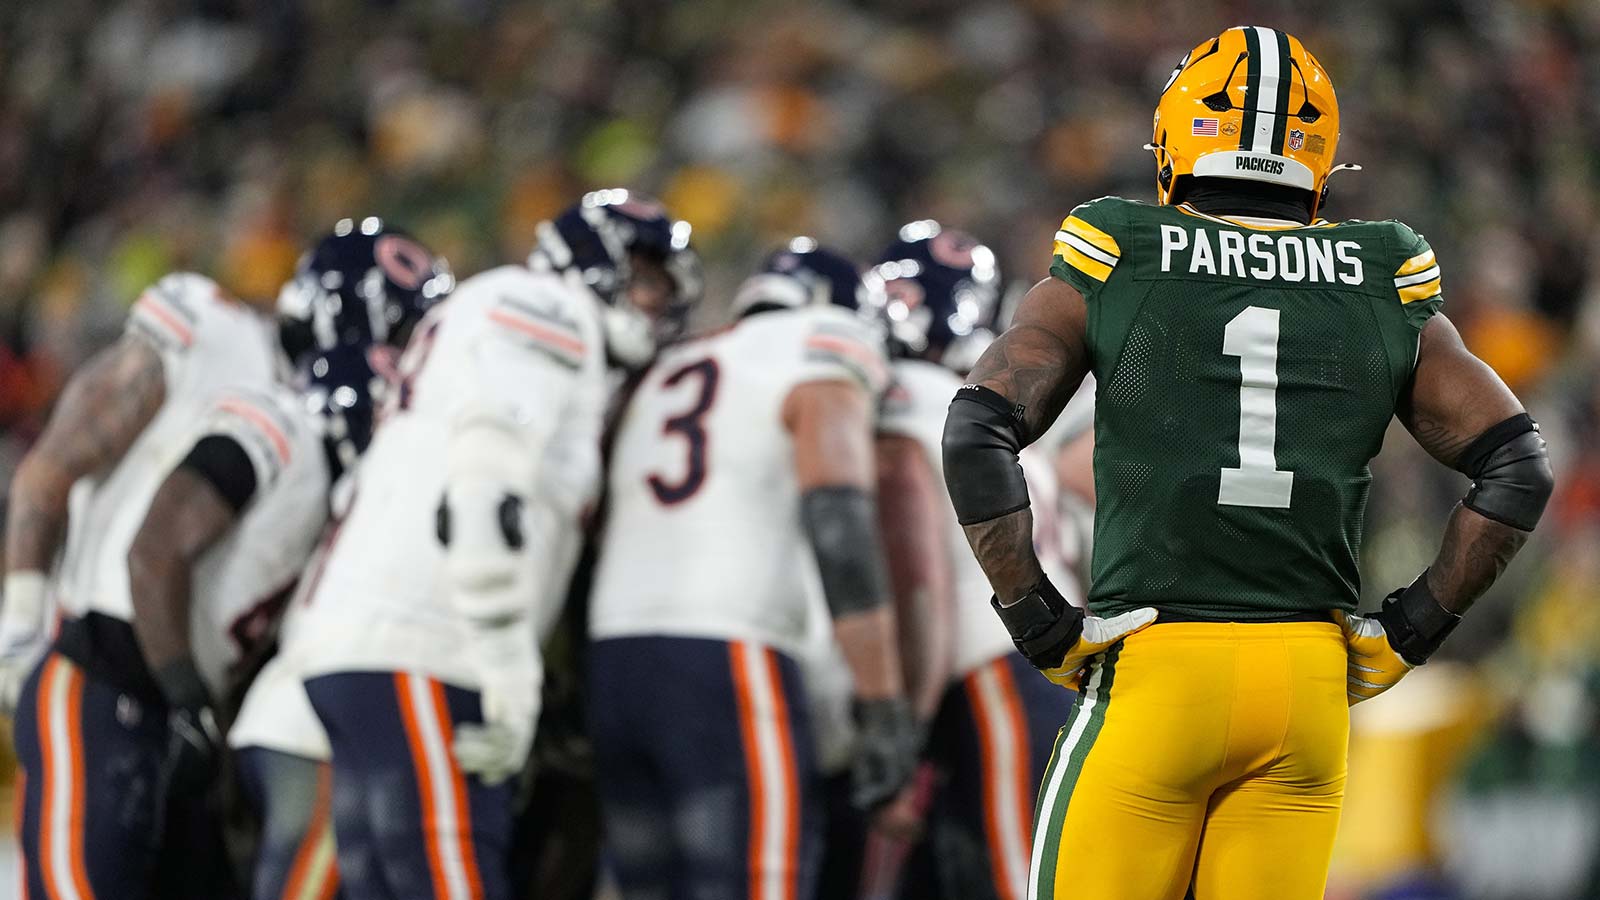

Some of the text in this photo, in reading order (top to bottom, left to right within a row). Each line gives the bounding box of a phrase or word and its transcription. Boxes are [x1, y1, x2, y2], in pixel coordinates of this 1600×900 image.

[1235, 156, 1285, 175] PACKERS
[1160, 224, 1364, 286] PARSONS
[646, 357, 719, 506] 3
[1217, 305, 1294, 509] 1
